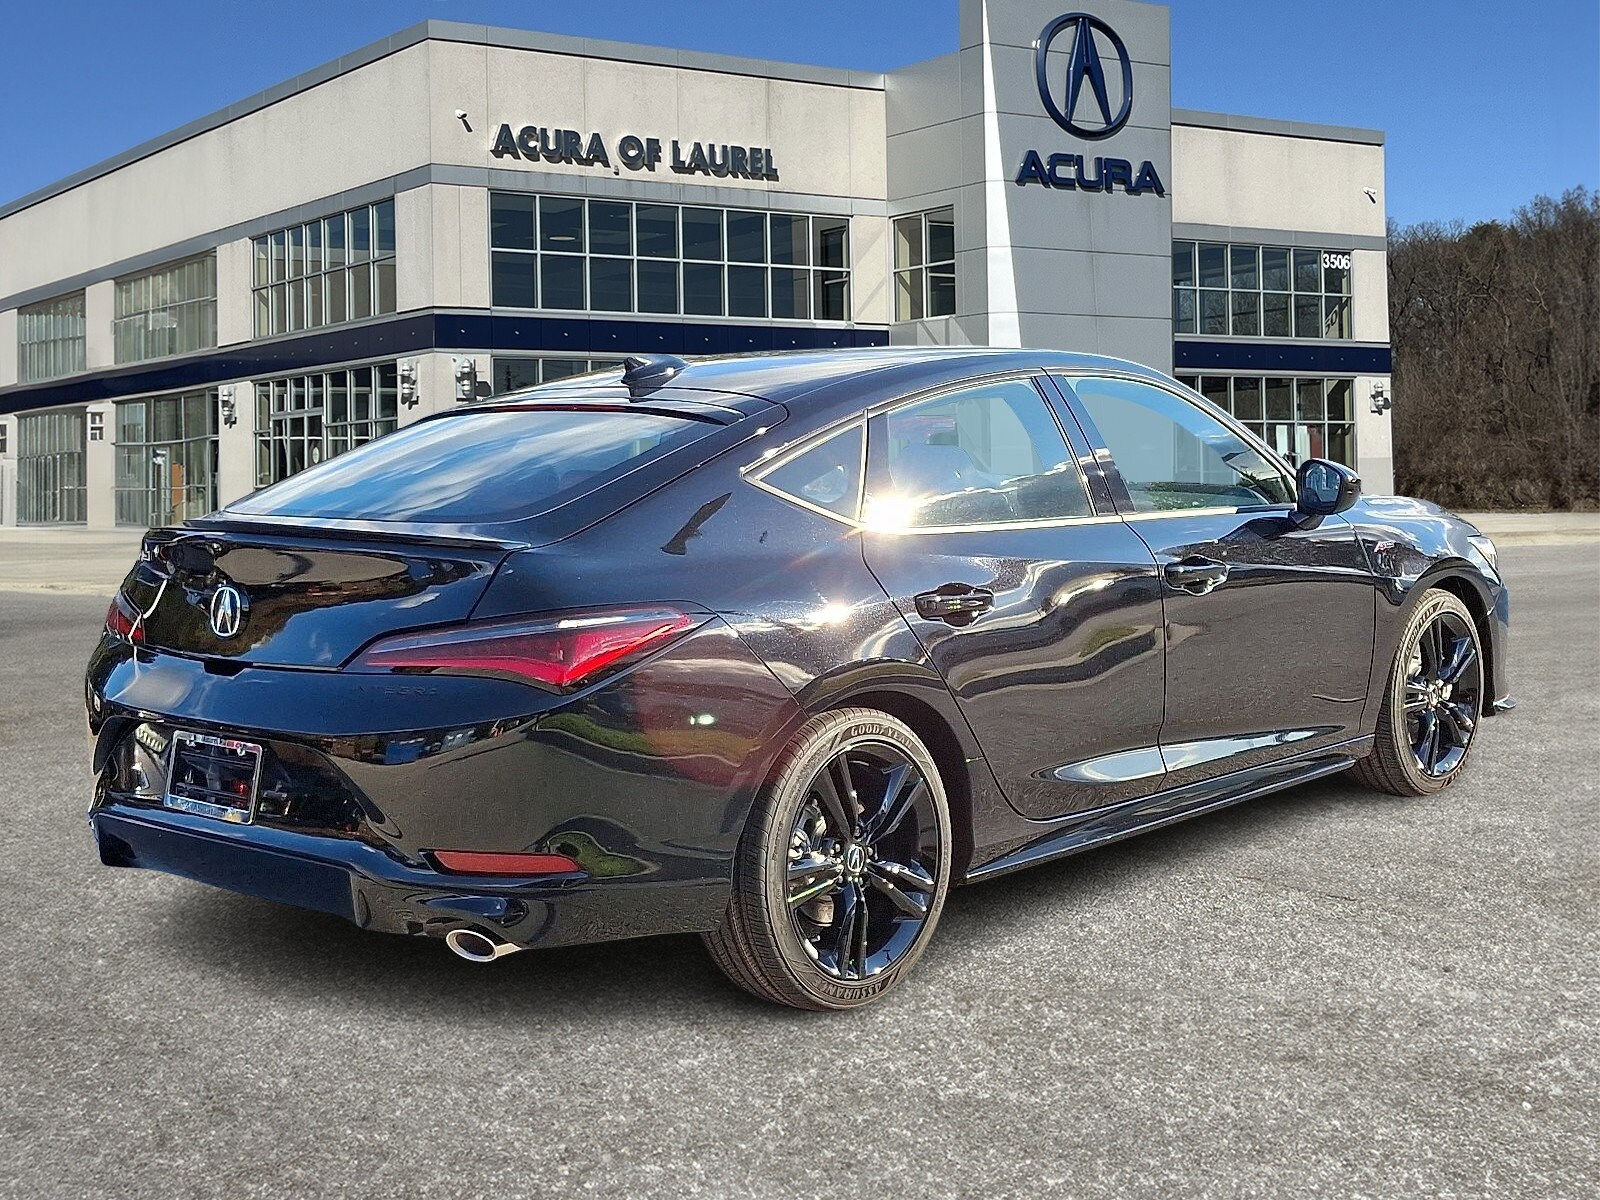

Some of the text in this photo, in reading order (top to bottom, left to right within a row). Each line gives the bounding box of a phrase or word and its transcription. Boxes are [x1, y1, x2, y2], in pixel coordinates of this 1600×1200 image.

[491, 123, 779, 181] ACURA OF LAUREL
[1016, 150, 1165, 197] ACURA
[1322, 253, 1350, 270] 3506
